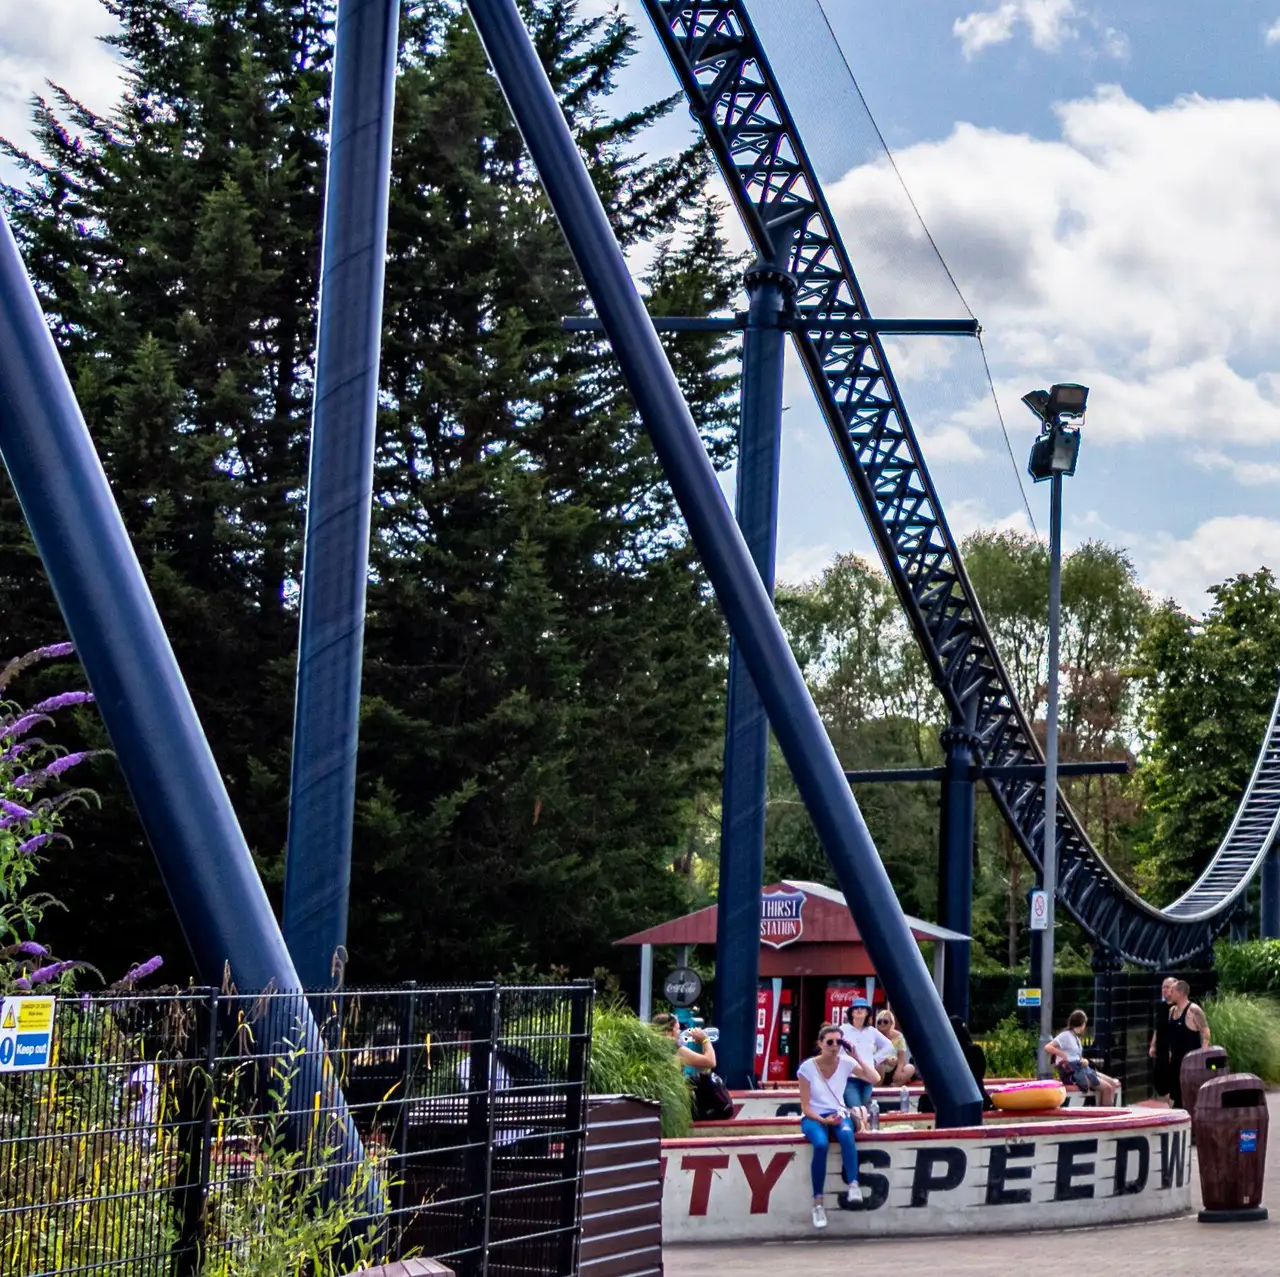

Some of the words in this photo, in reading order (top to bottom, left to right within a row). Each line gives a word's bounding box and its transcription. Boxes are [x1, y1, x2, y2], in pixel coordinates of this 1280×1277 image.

[762, 900, 796, 917] THIRST
[760, 920, 796, 936] STATION
[17, 1043, 34, 1056] Keep
[35, 1043, 47, 1053] out
